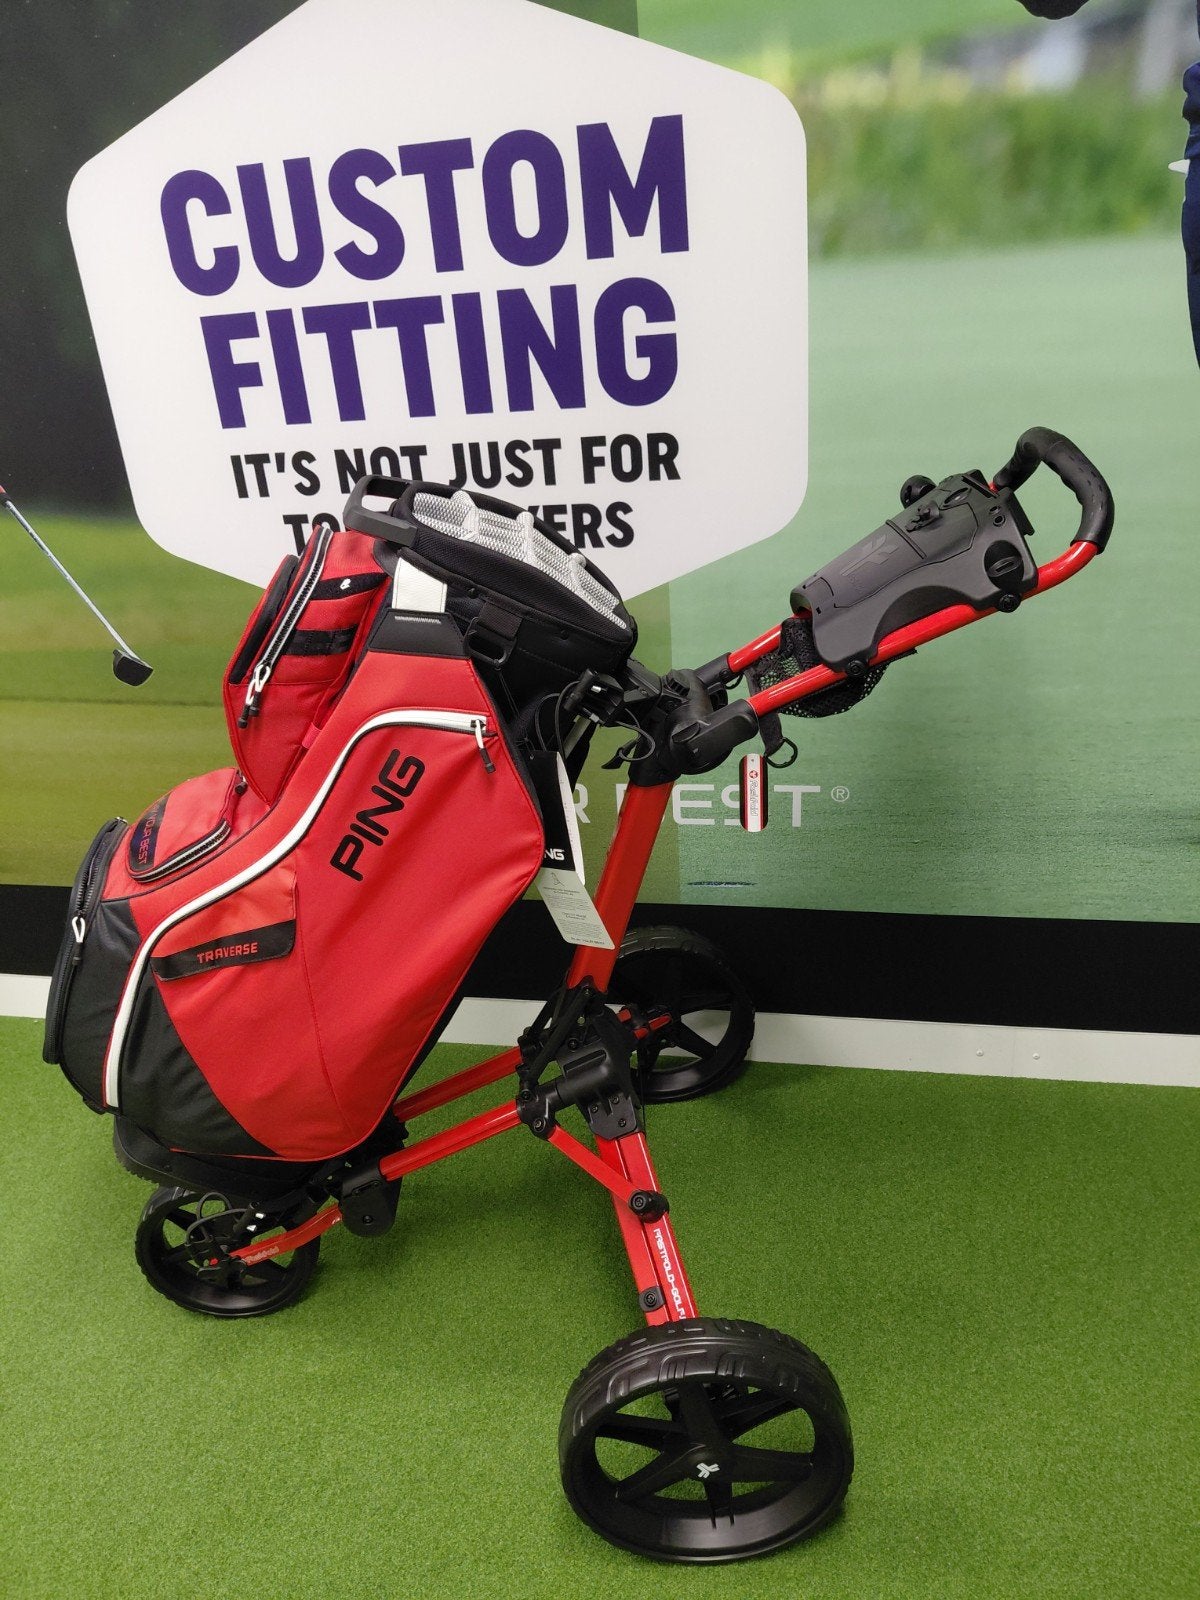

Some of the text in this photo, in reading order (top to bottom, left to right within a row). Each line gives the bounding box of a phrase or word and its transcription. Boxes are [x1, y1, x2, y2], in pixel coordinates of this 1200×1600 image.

[160, 114, 690, 297] CUSTOM
[200, 277, 678, 429] FITTING
[230, 432, 681, 498] IT'S NOT JUST FOR
[138, 838, 150, 864] BEST
[329, 748, 426, 882] PING
[196, 942, 258, 964] TRAVERSE
